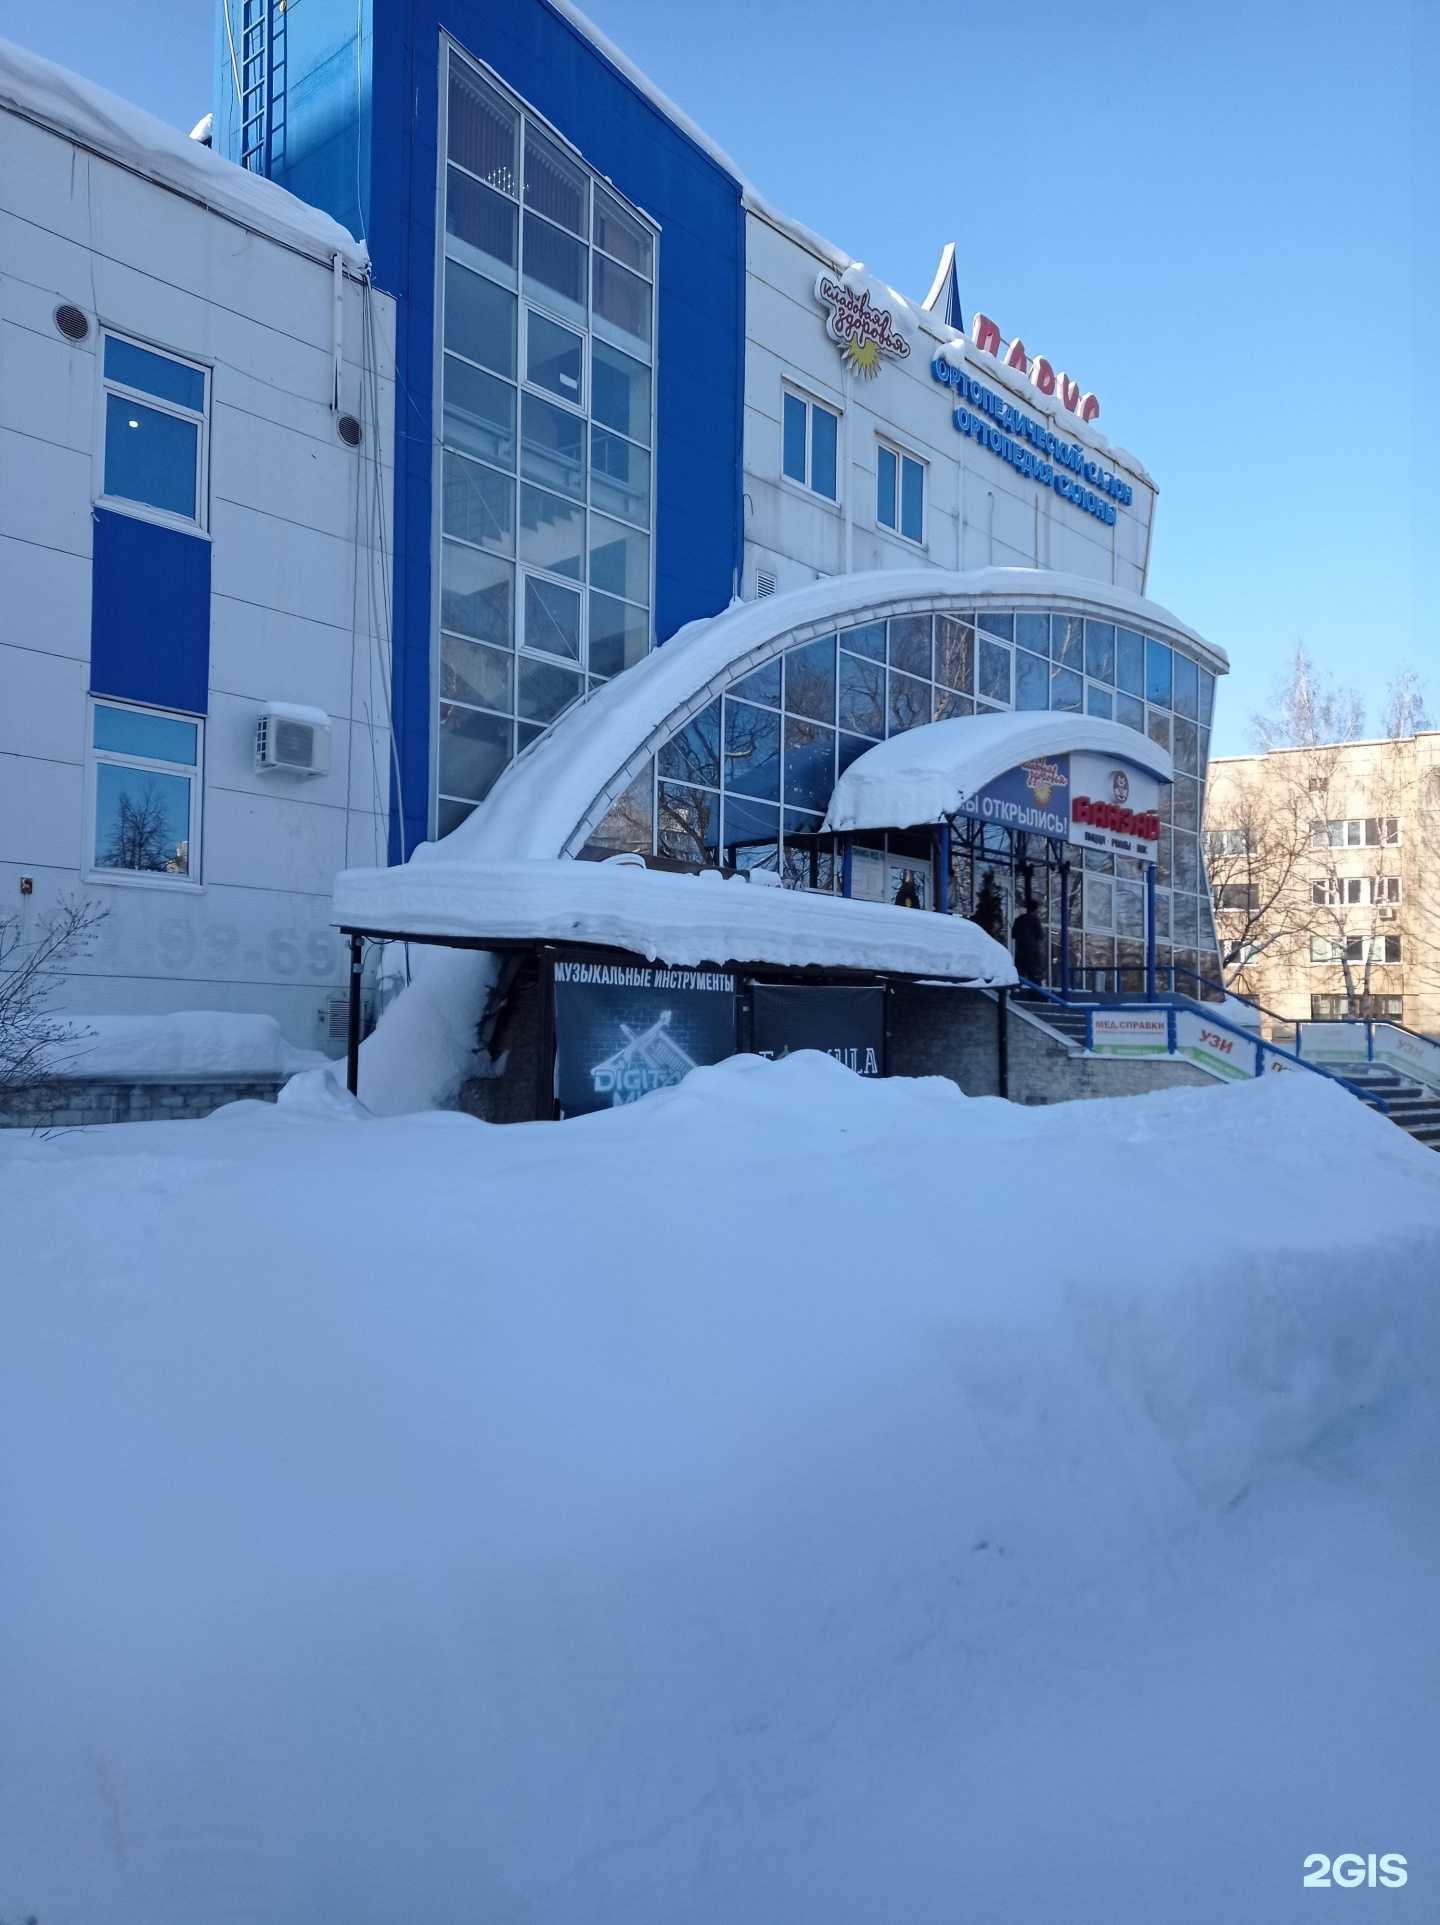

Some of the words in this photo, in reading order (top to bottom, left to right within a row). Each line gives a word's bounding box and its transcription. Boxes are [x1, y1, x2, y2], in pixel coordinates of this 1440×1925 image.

[931, 356, 1085, 479] ОРТОПЕДИЧЕСКИЙ
[1083, 461, 1133, 506] САЛОН
[953, 406, 1054, 488] ОРТОПЕДИЯ
[983, 797, 1067, 834] ОТКРЫЛИСЬ!
[554, 962, 651, 987] МУЗЫКАЛЬНЫЕ
[653, 970, 734, 992] ИНСТРУМЕНТЫ
[1200, 1029, 1233, 1054] УЗИ
